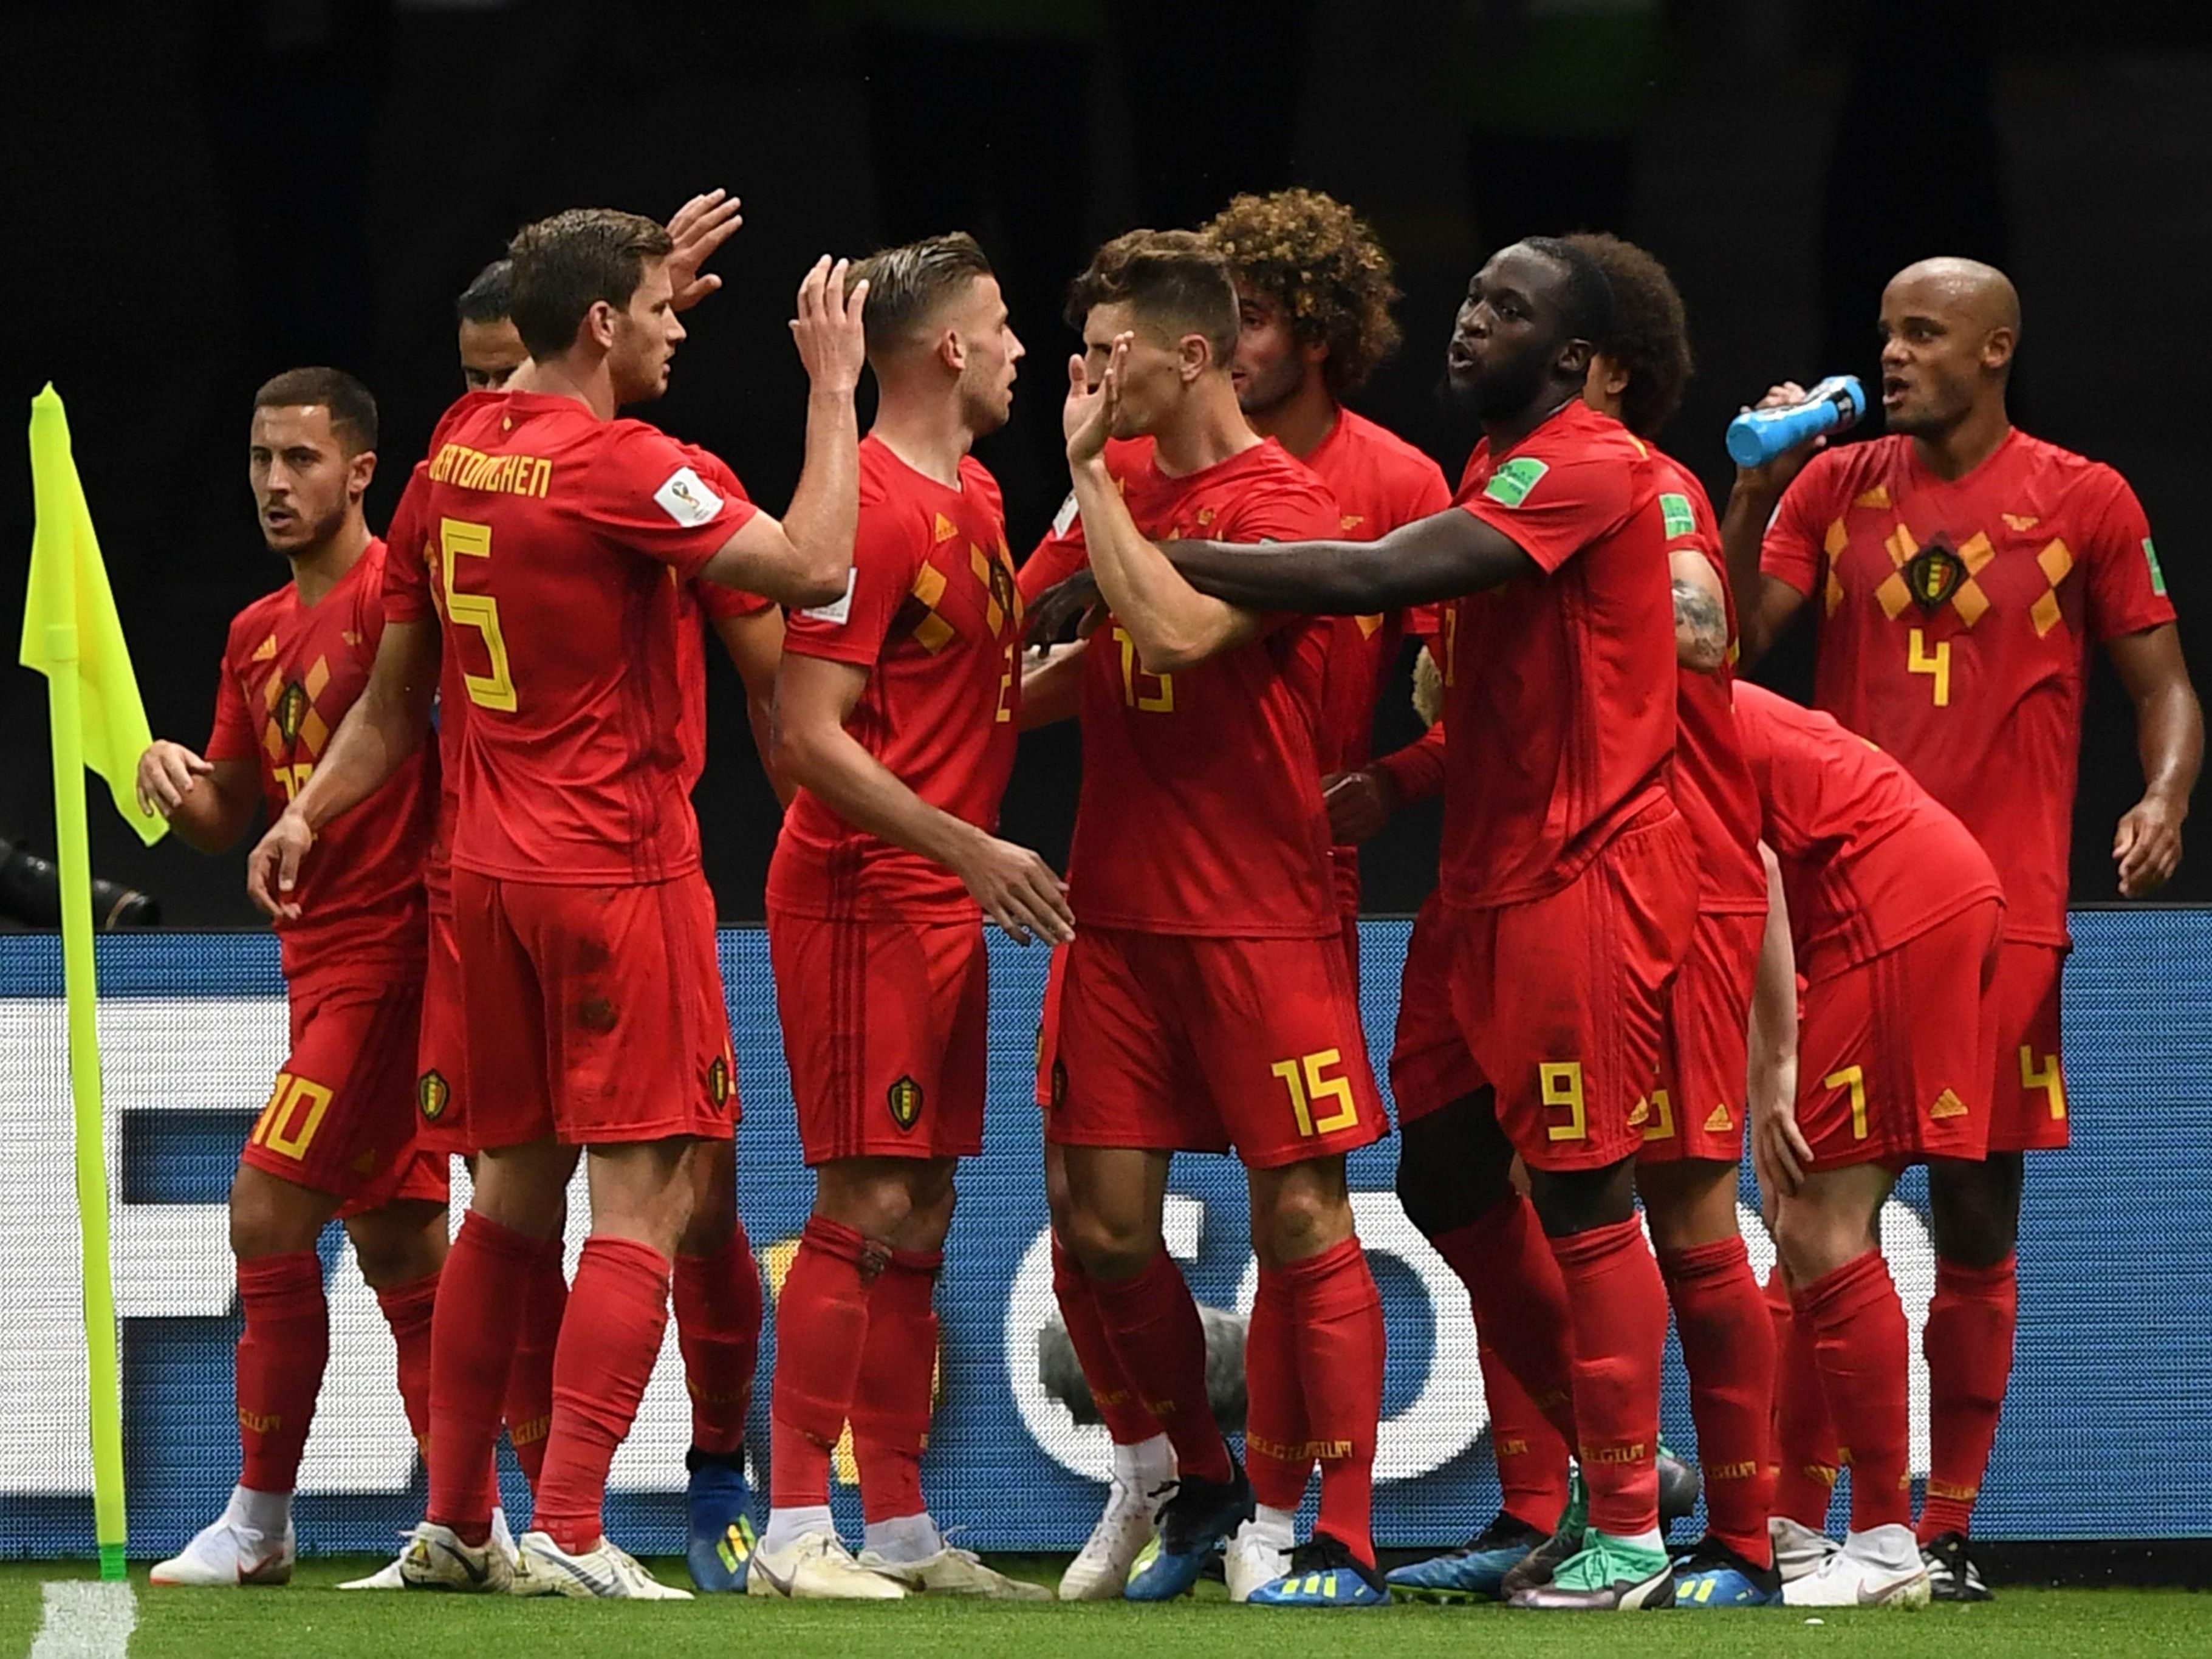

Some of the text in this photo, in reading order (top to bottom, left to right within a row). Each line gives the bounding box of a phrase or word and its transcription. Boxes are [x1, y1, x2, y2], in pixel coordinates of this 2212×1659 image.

[441, 518, 517, 712] 5
[1909, 629, 1950, 706] 4
[252, 1073, 334, 1161] 10
[1271, 1048, 1358, 1137] 15
[1539, 1062, 1586, 1141] 9
[1825, 1065, 1867, 1140] 7
[2021, 1045, 2065, 1120] 4
